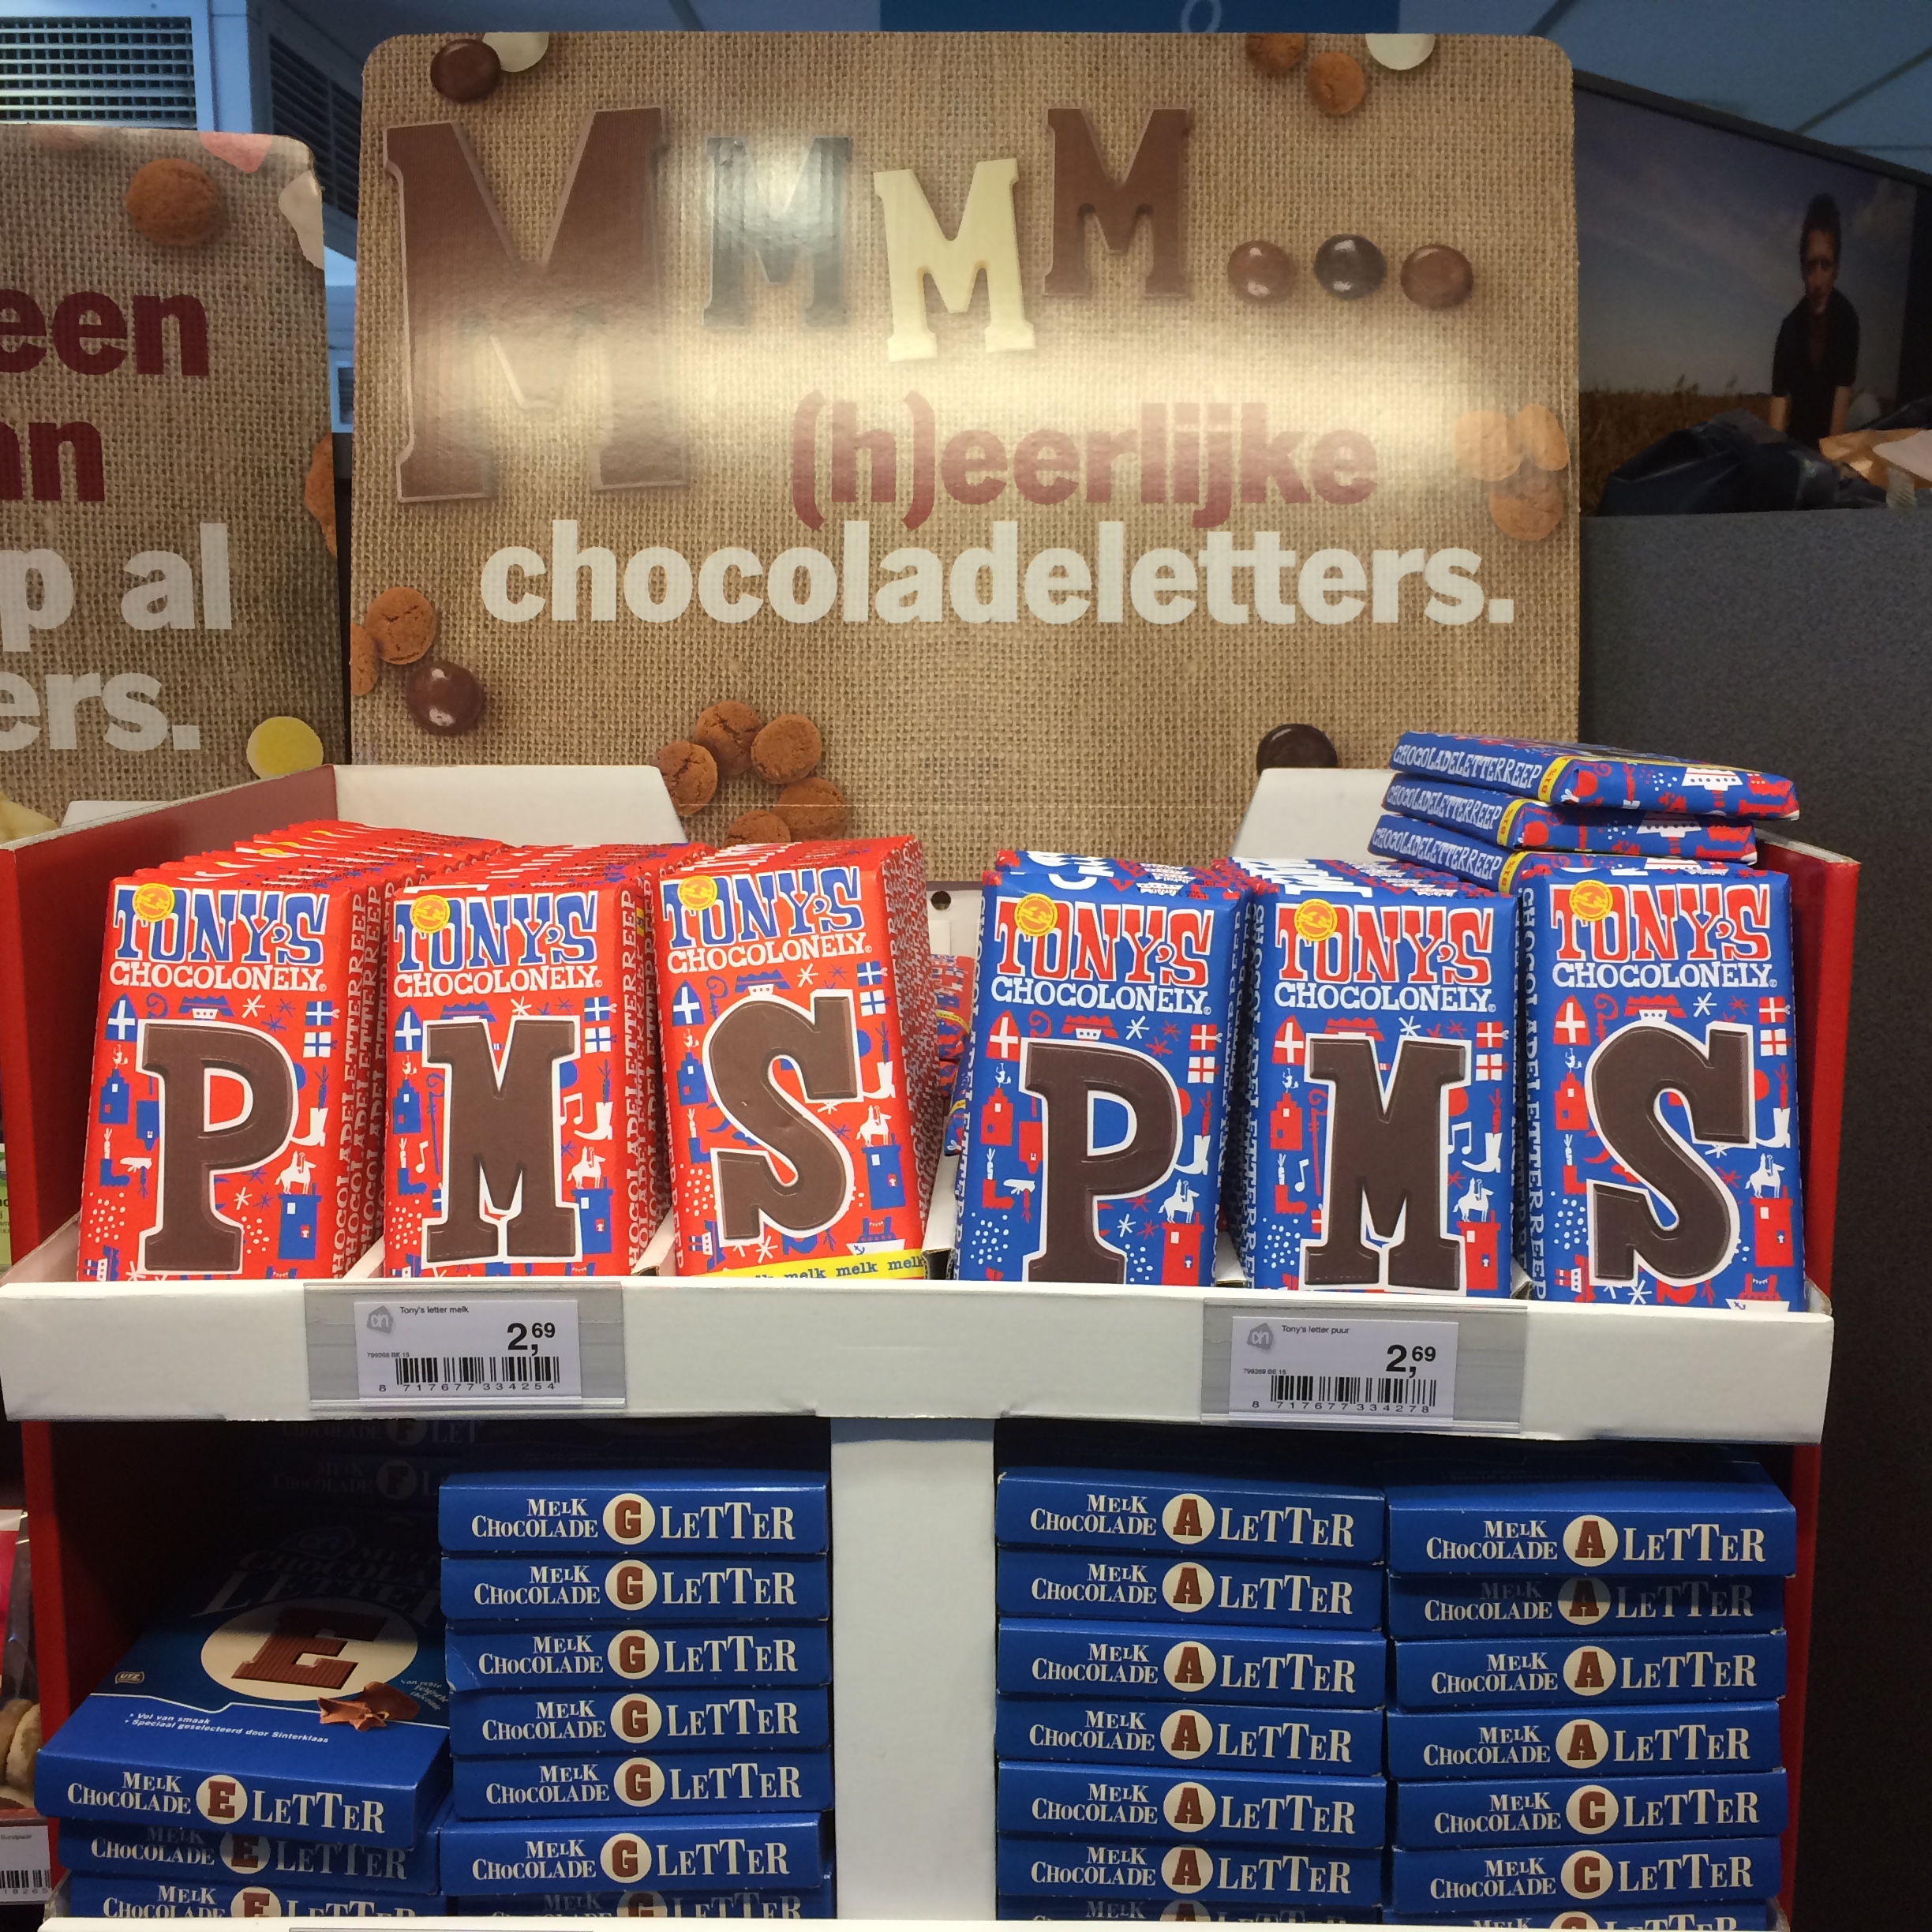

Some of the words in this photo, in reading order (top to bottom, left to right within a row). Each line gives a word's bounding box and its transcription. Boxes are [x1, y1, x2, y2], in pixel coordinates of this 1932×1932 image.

[793, 389, 1378, 530] (h)eerlijke
[121, 522, 231, 630] al
[481, 519, 1514, 626] chocoladeletters.
[114, 887, 330, 964] TONY'S
[660, 867, 863, 949] TONY'S
[1551, 883, 1770, 961] TONY'S
[395, 890, 598, 970] TONY'S
[996, 895, 1212, 985] TONY'S
[1275, 904, 1494, 985] TONY'S
[668, 932, 867, 974] CHOCOLONELY
[110, 963, 324, 992] CHOCOLONELY
[395, 967, 598, 996] CHOCOLONELY
[1552, 960, 1773, 988] CHOCOLONELY
[990, 978, 1208, 1014] CHOCOLONELY
[1274, 982, 1493, 1013] CHOCOLONELY
[702, 989, 864, 1246] S
[137, 1019, 298, 1275] P
[421, 1017, 582, 1269] M
[1019, 1037, 1184, 1282] P
[1586, 1021, 1756, 1286] S
[1300, 1033, 1471, 1295] M
[836, 1262, 878, 1277] melk
[399, 1306, 425, 1315] Tony's
[1281, 1325, 1307, 1334] Tony's
[616, 1500, 641, 1537] G
[1174, 1500, 1201, 1535] A
[1576, 1521, 1605, 1558] A
[617, 1567, 642, 1604] G
[1174, 1568, 1201, 1604] A
[231, 1605, 387, 1690] E
[620, 1636, 645, 1672] G
[1175, 1647, 1203, 1683] A
[1575, 1652, 1604, 1687] A
[131, 1720, 175, 1729] Speciaal
[177, 1723, 242, 1735] geselecteerd
[245, 1728, 269, 1738] door
[271, 1732, 329, 1743] Sinterklaas
[178, 1716, 211, 1724] smaak
[623, 1701, 648, 1736] G
[1172, 1716, 1200, 1751] A
[1567, 1724, 1596, 1760] A
[208, 1781, 235, 1818] E
[626, 1765, 650, 1800] G
[1175, 1788, 1203, 1824] A
[1580, 1792, 1604, 1828] C
[231, 1833, 260, 1868] E
[612, 1840, 638, 1877] G
[1173, 1850, 1200, 1885] A
[1574, 1857, 1600, 1893] C
